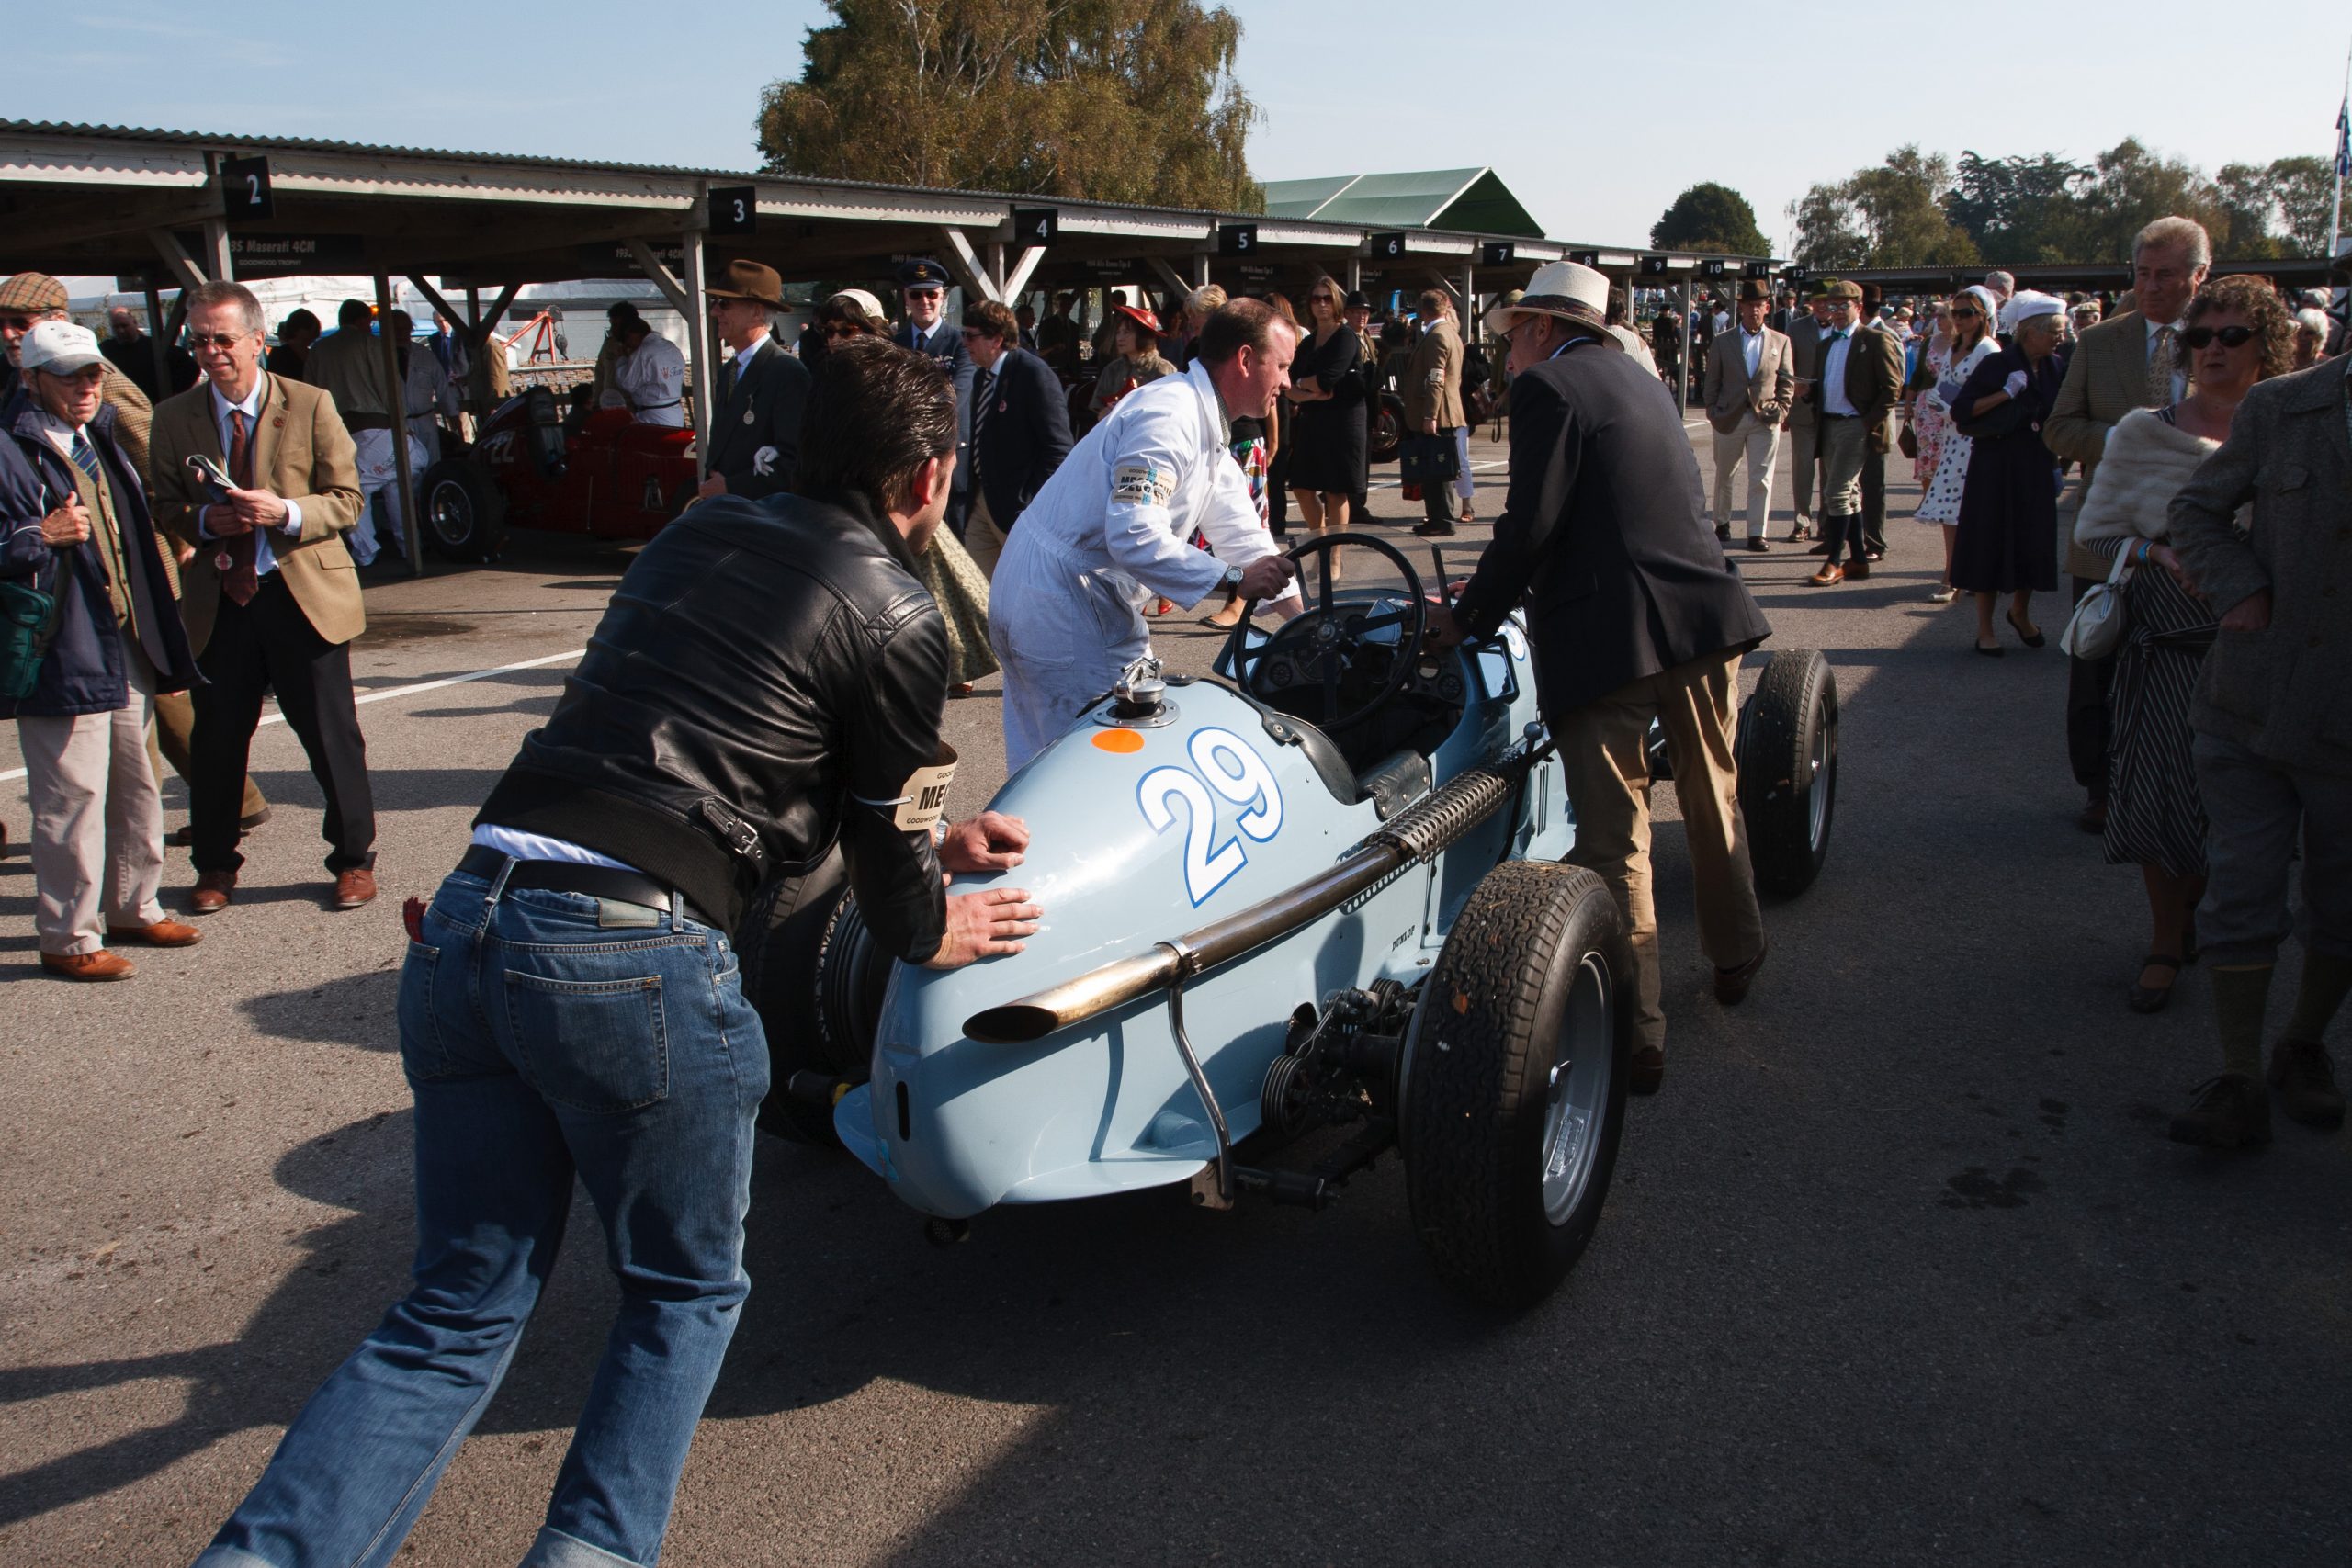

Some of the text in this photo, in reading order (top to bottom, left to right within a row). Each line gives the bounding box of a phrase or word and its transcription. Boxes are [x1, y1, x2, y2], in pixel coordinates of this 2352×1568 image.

[246, 174, 262, 204] 2
[733, 198, 745, 222] 3
[1036, 219, 1048, 238] 4
[246, 240, 290, 253] Maserati
[292, 240, 316, 254] 4CM
[1238, 232, 1248, 249] 5
[1388, 240, 1398, 254] 6
[1498, 248, 1508, 261] 7
[1584, 256, 1592, 266] 8
[1655, 261, 1662, 271] 9
[1709, 264, 1722, 274] 10
[1756, 265, 1766, 275] 11
[1793, 269, 1804, 277] 12
[1136, 726, 1284, 909] 29
[1392, 924, 1415, 952] DUNLOP
